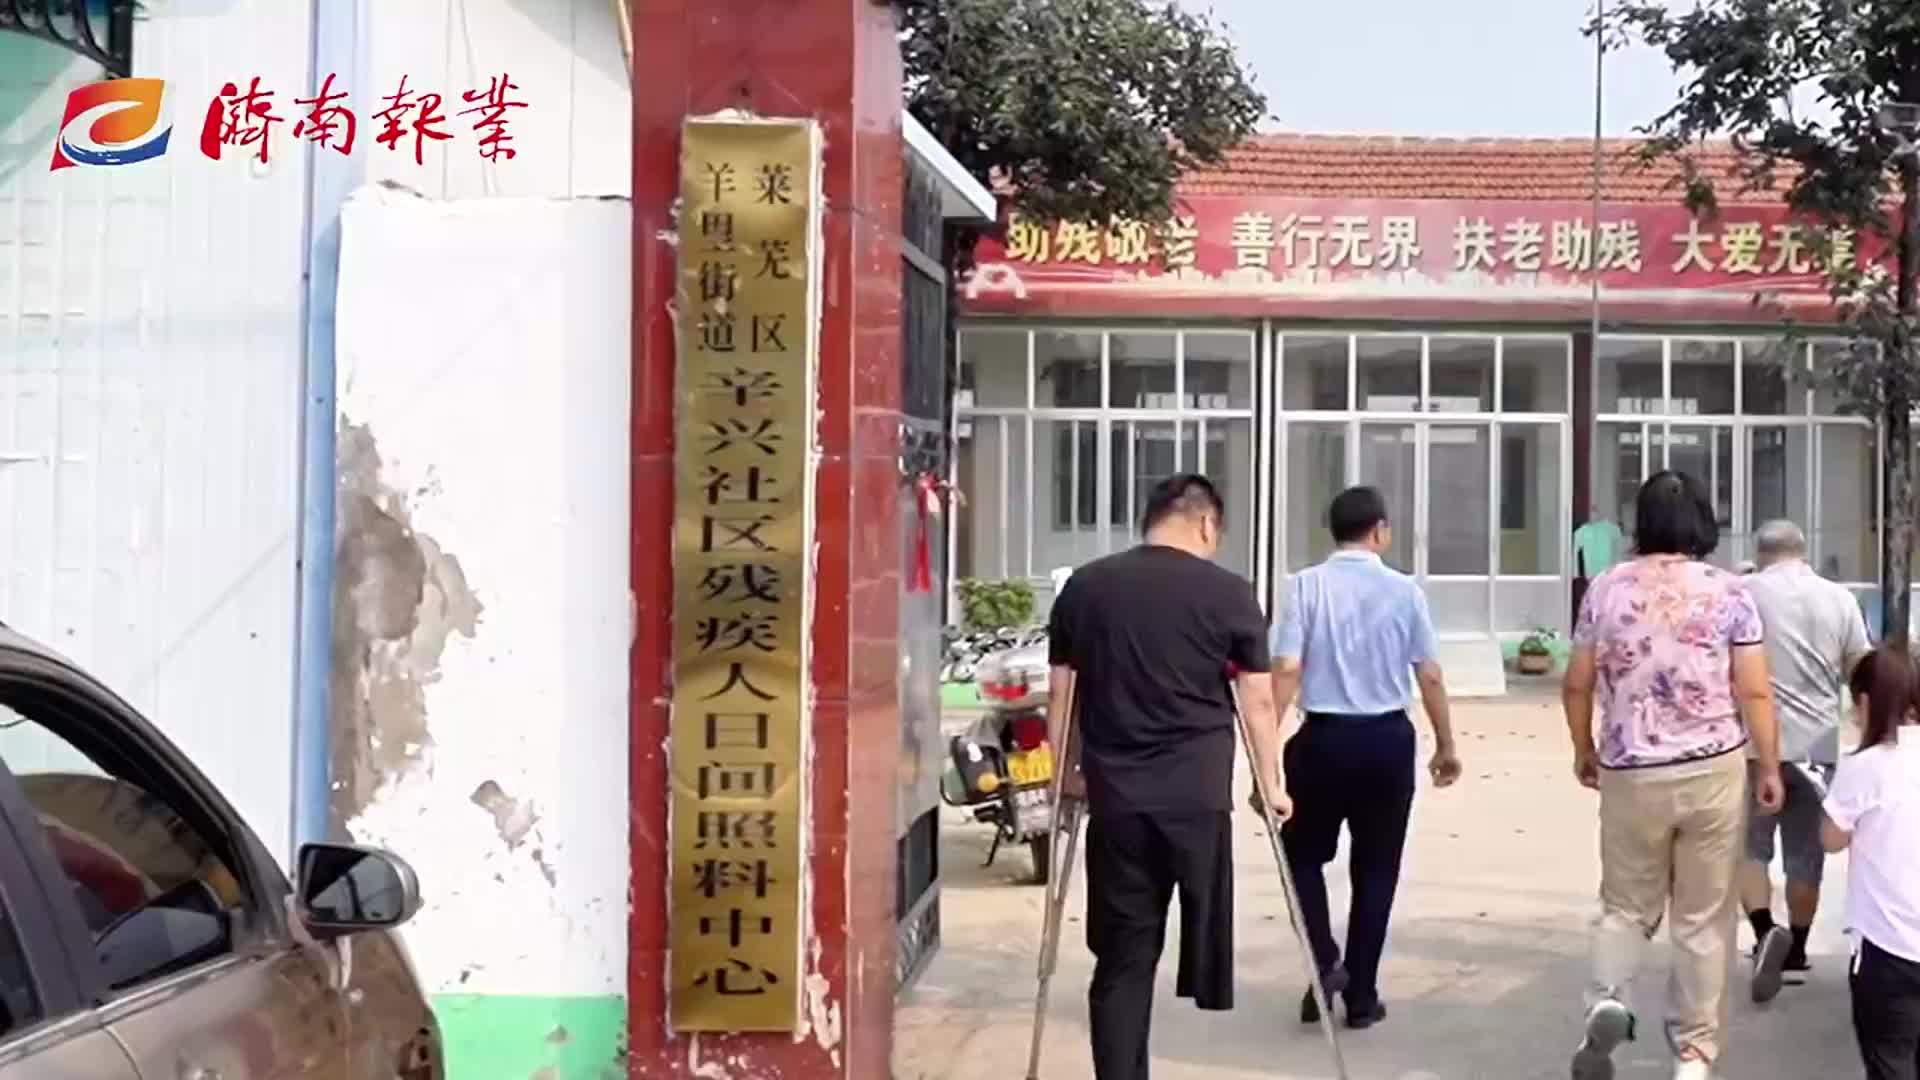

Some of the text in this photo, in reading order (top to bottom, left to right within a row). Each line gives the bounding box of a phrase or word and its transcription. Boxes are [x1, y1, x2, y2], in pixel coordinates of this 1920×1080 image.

[697, 161, 737, 353] 羊里街道
[753, 163, 791, 353] 莱芜区
[1231, 211, 1422, 270] 善行无界
[1453, 216, 1643, 272] 扶老助残
[692, 367, 783, 996] 辛兴社区残疾人日间照料中心
